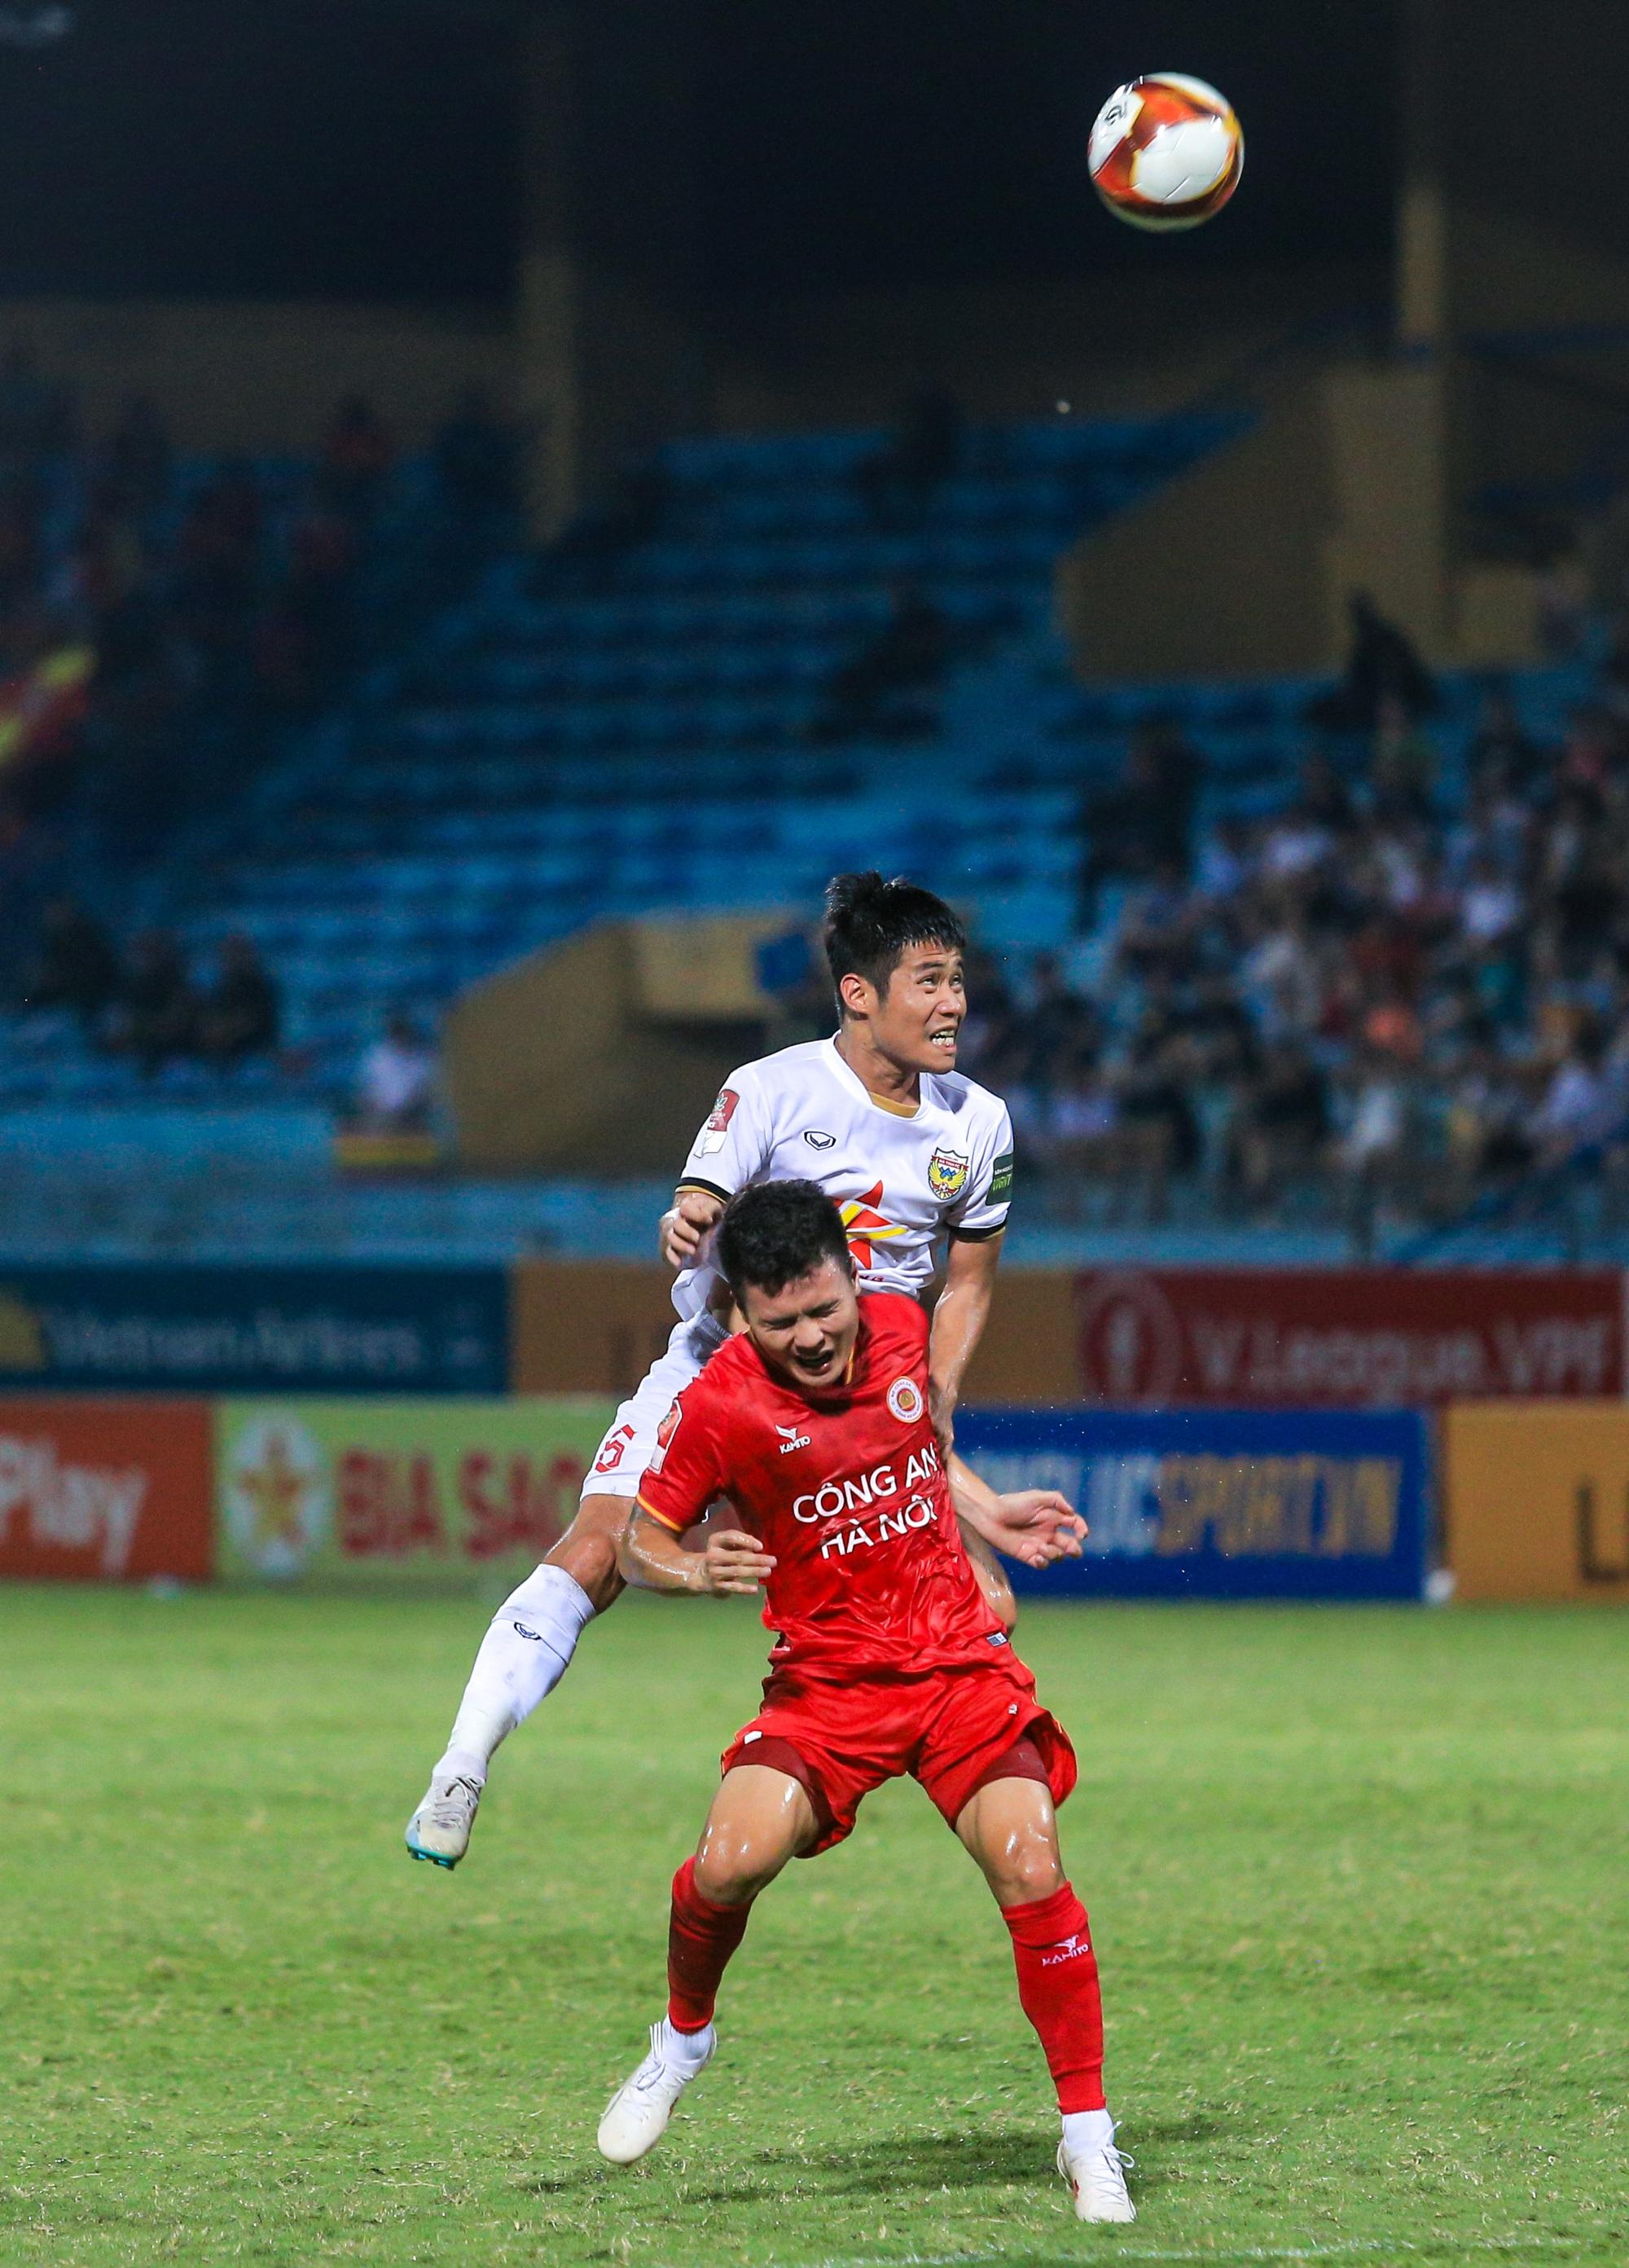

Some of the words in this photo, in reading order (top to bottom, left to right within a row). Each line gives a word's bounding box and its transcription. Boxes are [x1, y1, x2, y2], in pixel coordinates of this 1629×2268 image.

[793, 1465, 898, 1523] CÔNG
[905, 1442, 938, 1488] AN
[821, 1518, 874, 1559] HÀ
[1042, 1944, 1089, 1967] KAMITO
